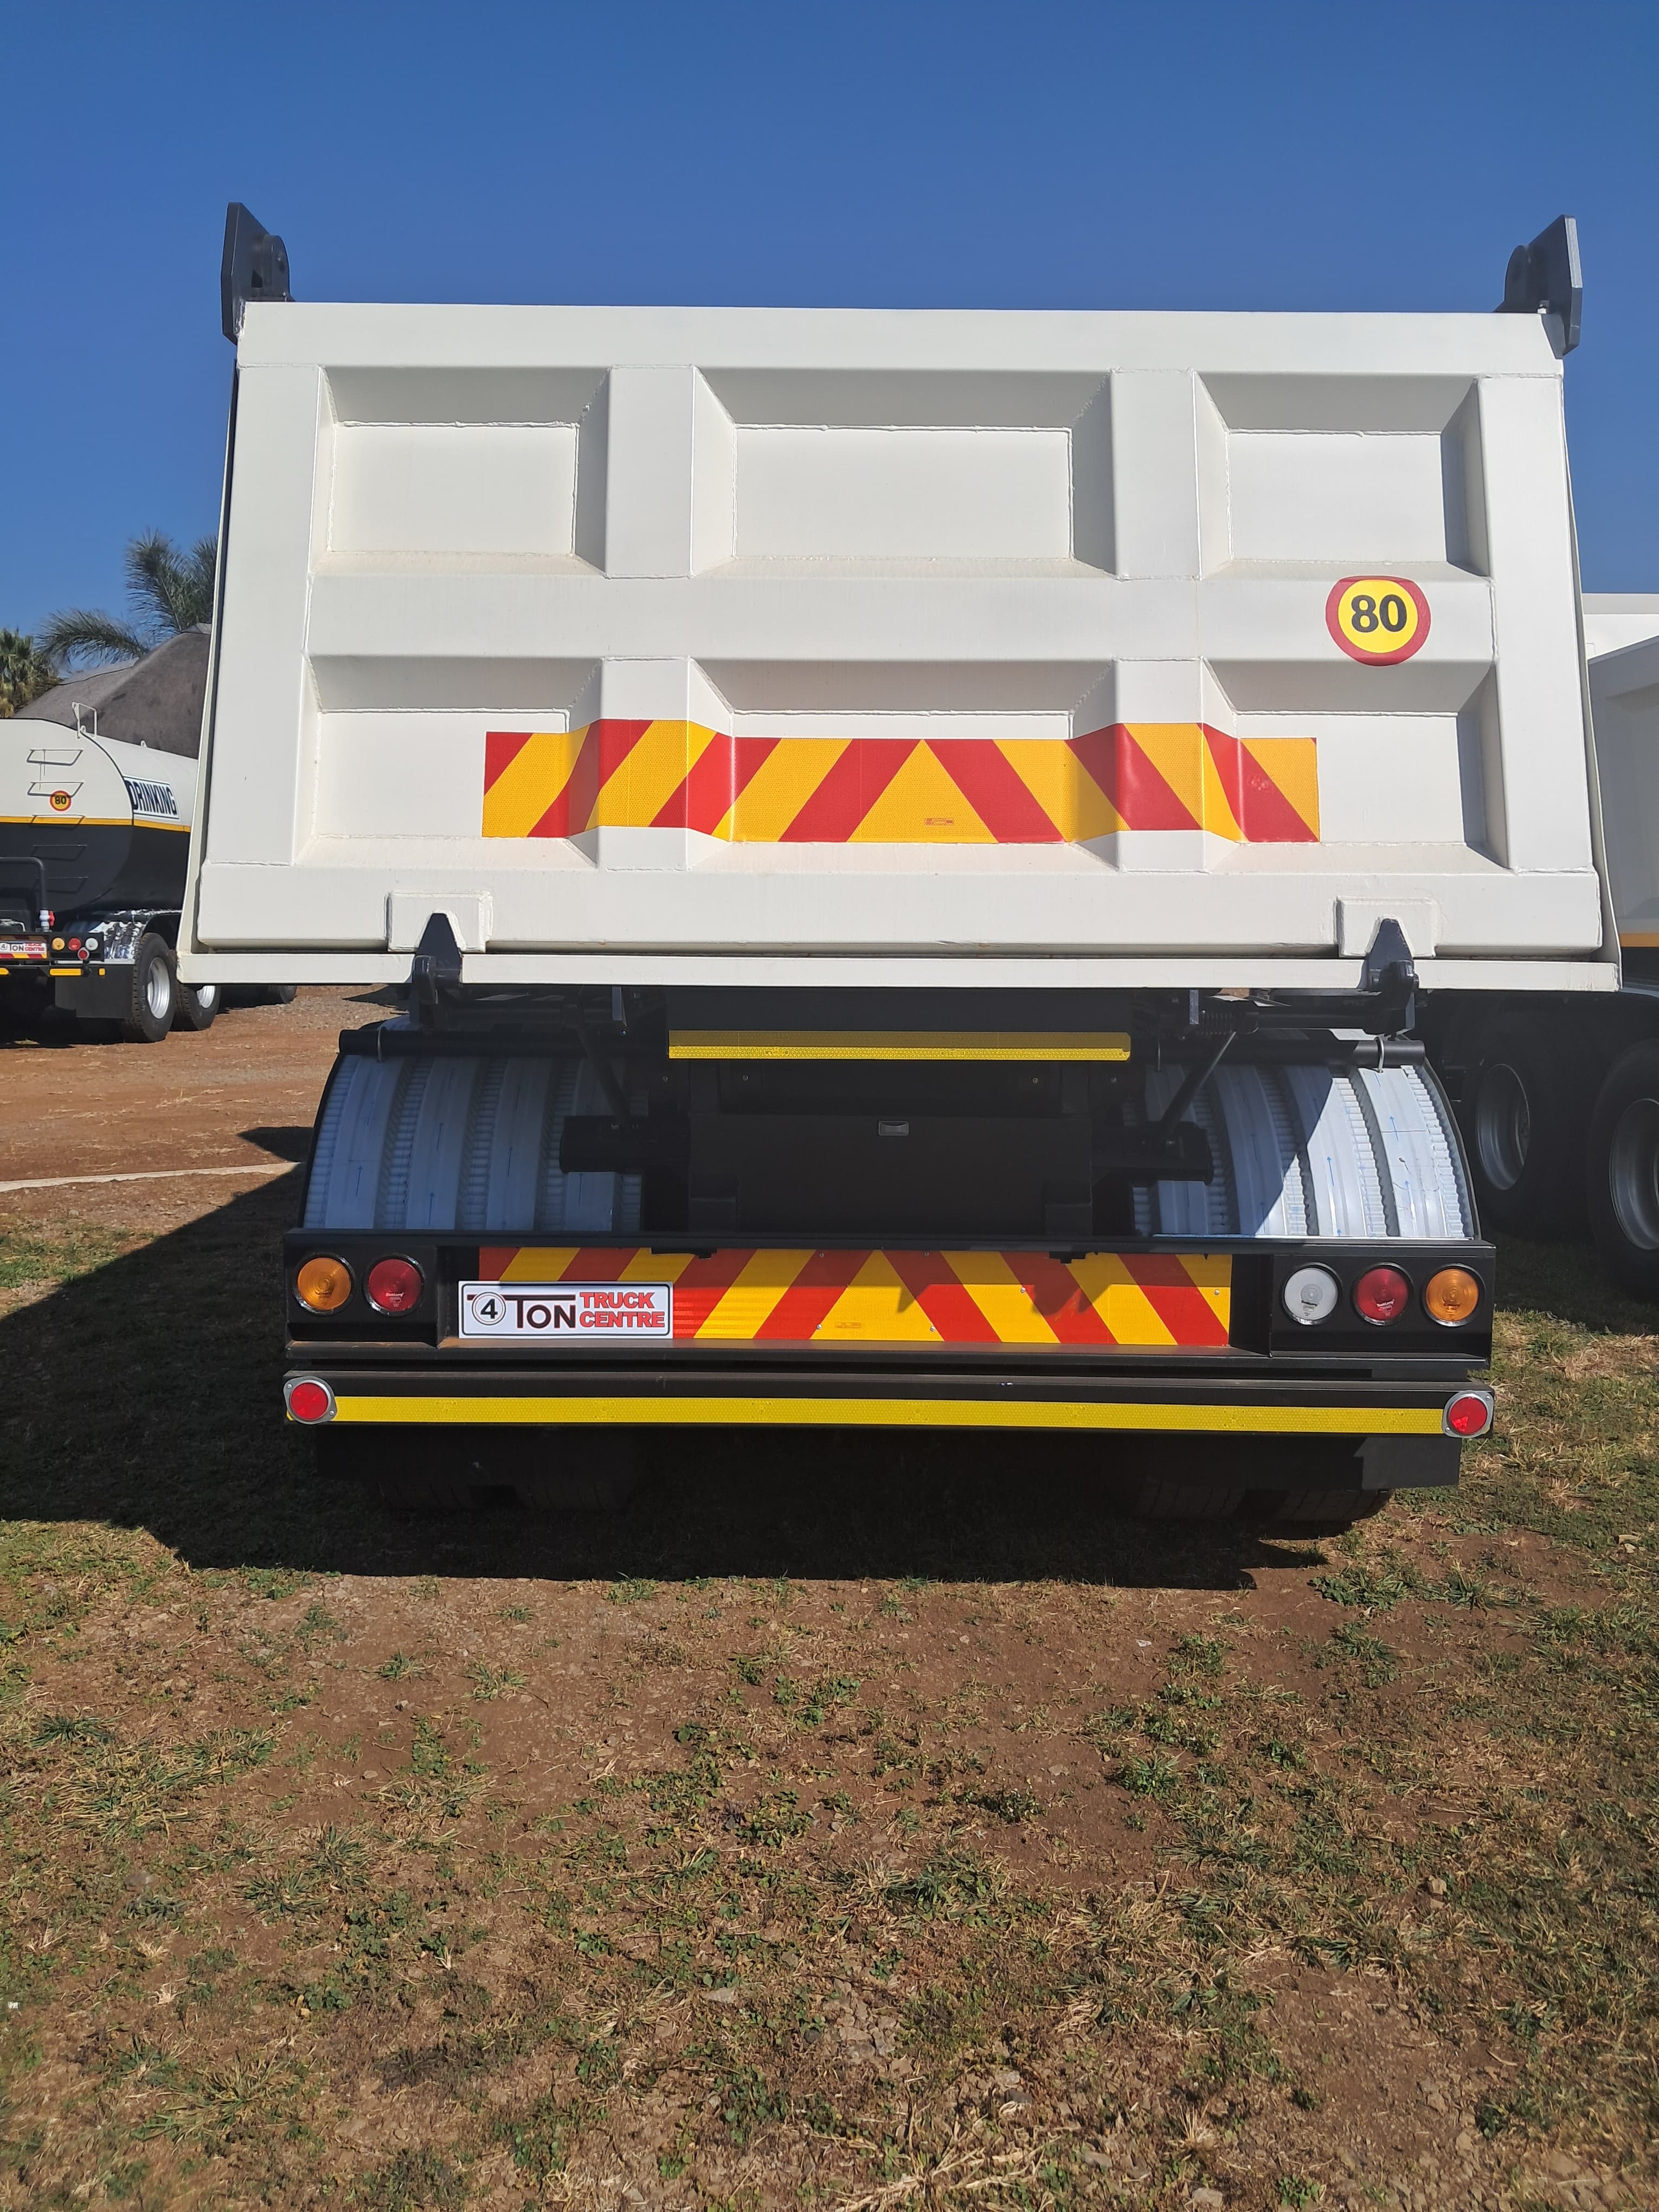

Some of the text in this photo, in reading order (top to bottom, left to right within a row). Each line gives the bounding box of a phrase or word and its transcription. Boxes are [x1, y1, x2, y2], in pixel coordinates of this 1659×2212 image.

[1351, 594, 1407, 633] 80
[55, 796, 67, 805] 80
[124, 780, 178, 815] DRINKING
[480, 1294, 576, 1329] 4 TON
[580, 1292, 654, 1309] TRUCK
[580, 1311, 665, 1328] CENTRE
